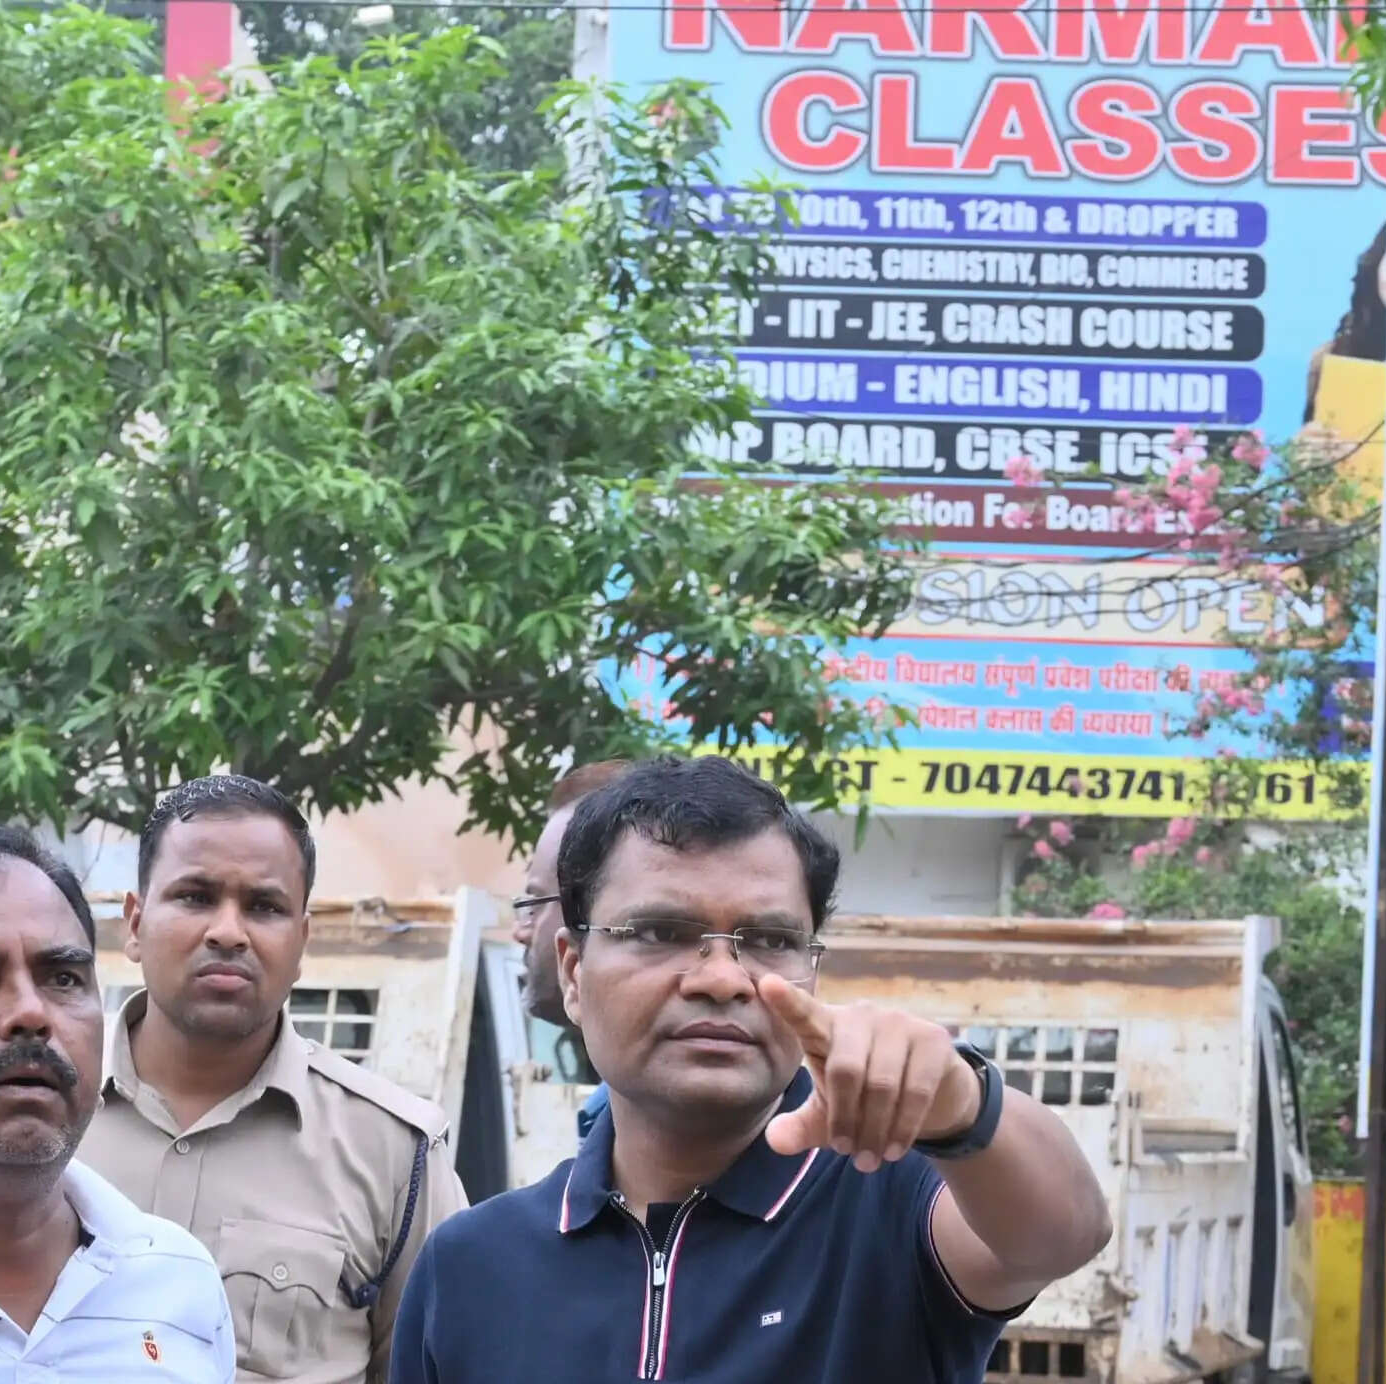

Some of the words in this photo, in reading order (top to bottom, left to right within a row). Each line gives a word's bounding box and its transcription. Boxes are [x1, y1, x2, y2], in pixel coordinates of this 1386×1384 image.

[874, 198, 955, 233] 11th,
[960, 200, 1037, 233] 12th
[1042, 206, 1072, 235] &
[1076, 203, 1240, 239] DROPPER
[881, 248, 1037, 287] CHEMISTRY,
[1039, 253, 1094, 289] BIO,
[1097, 255, 1250, 291] COMMERCE
[787, 299, 842, 339] IIT
[867, 301, 936, 346] JEE,
[942, 302, 1074, 347] CRASH
[1079, 307, 1234, 352] COURSE
[893, 364, 1091, 414] ENGLISH,
[1098, 369, 1229, 414] HINDI
[770, 420, 948, 473] BOARD,
[1124, 574, 1327, 634] OPEN
